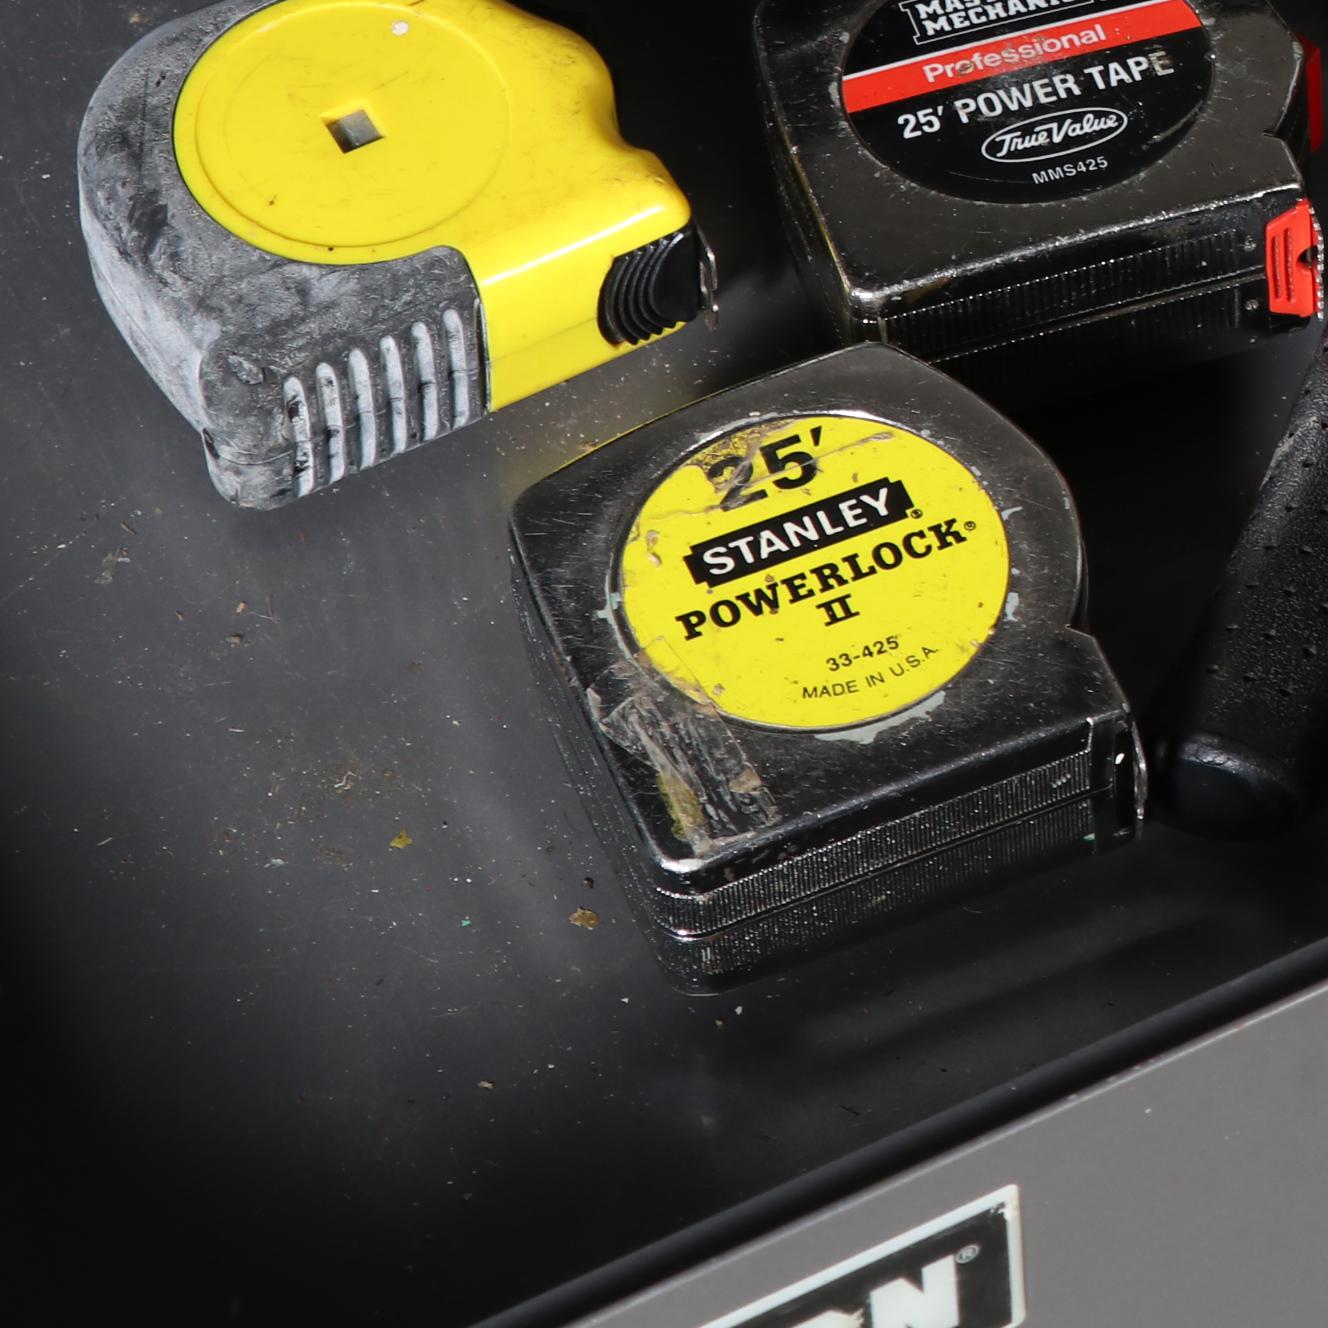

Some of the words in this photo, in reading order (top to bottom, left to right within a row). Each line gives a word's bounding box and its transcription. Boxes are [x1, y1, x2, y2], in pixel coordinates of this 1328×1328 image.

[922, 25, 1106, 84] Professional
[897, 106, 944, 140] 25'
[954, 76, 1082, 124] POWER
[1084, 51, 1176, 97] TAPE
[1032, 156, 1109, 184] MMS425
[707, 426, 823, 512] 25'
[702, 487, 892, 576] STANLEY
[675, 518, 967, 641] POWERLOCK
[816, 593, 860, 627] II
[802, 680, 860, 700] MADE
[865, 673, 884, 688] IN
[890, 647, 940, 678] U.S.A.
[825, 635, 900, 671] 33-425
